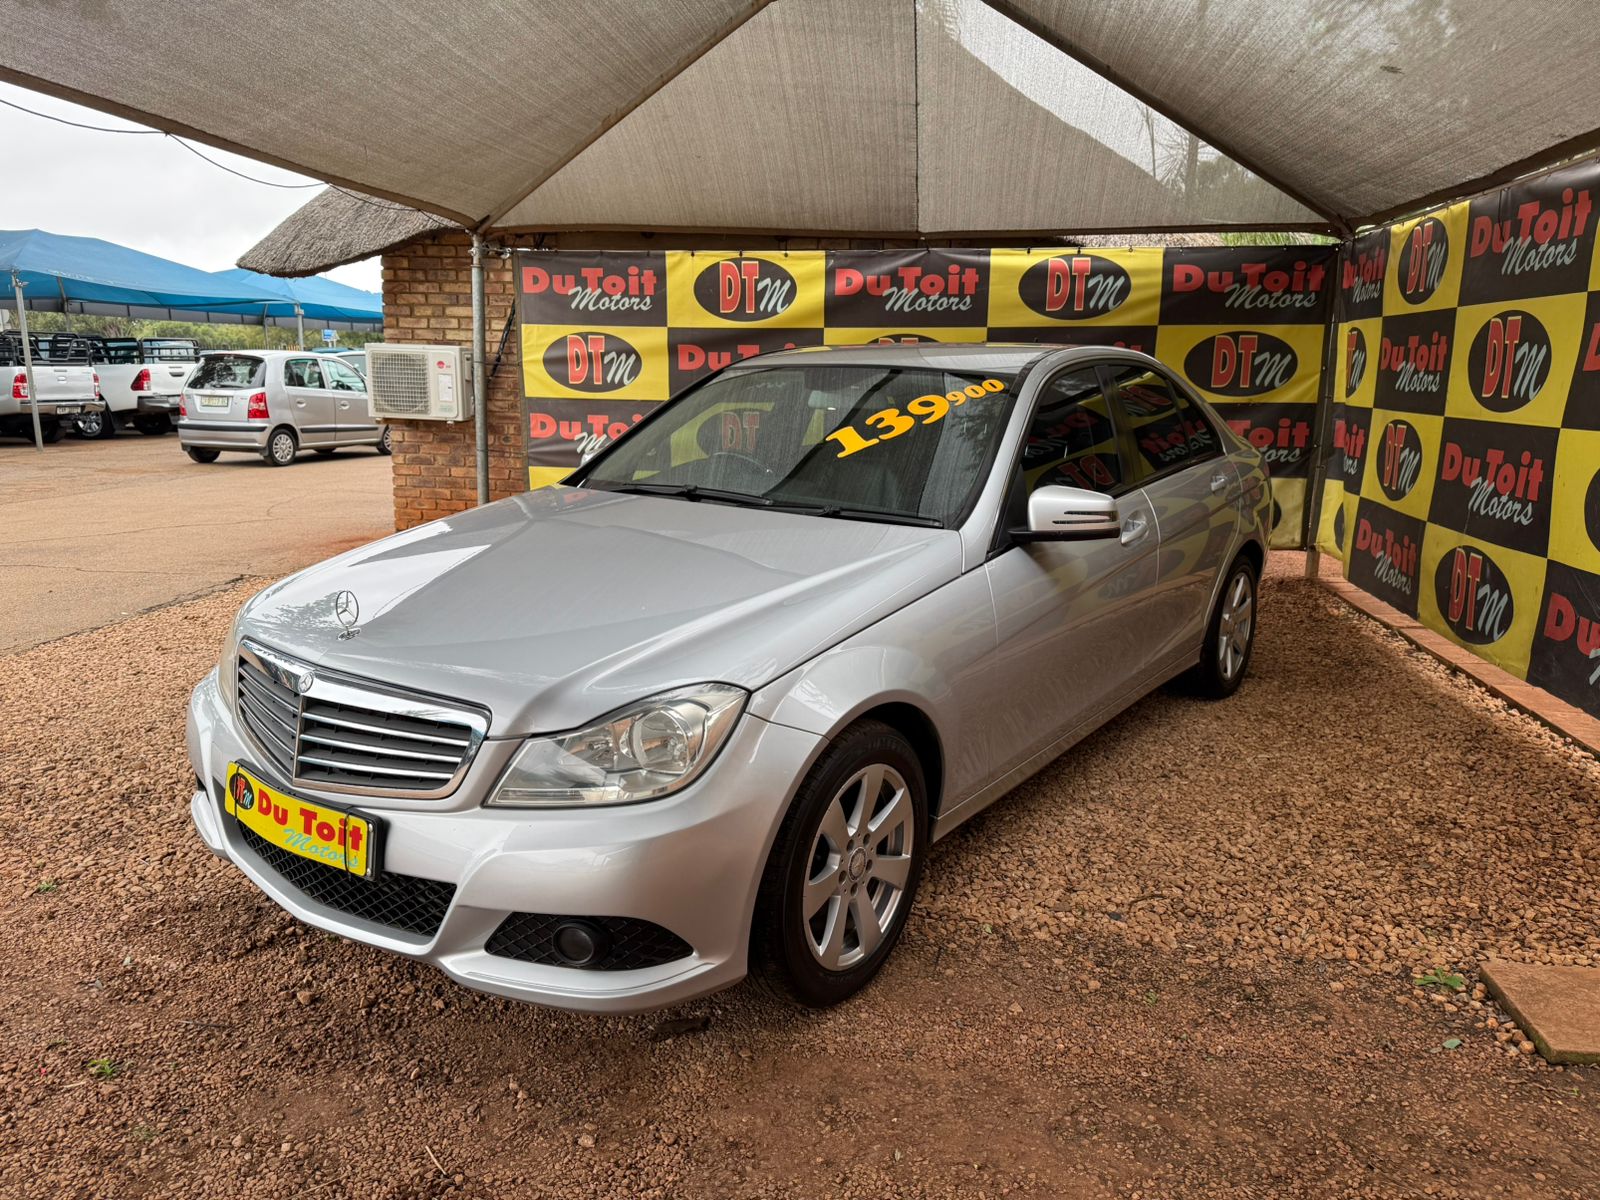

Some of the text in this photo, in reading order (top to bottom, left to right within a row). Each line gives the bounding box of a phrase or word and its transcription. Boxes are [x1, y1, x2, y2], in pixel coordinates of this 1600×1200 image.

[1501, 236, 1577, 275] Motors
[567, 285, 653, 312] Motors
[881, 286, 974, 313] Motors
[1222, 283, 1318, 310] Motors
[1352, 276, 1381, 304] Motors
[1395, 362, 1441, 393] Motors
[1468, 476, 1534, 525] Motors
[1374, 550, 1412, 595] Motors
[257, 788, 363, 852] Du Toit
[283, 827, 360, 869] Motors
